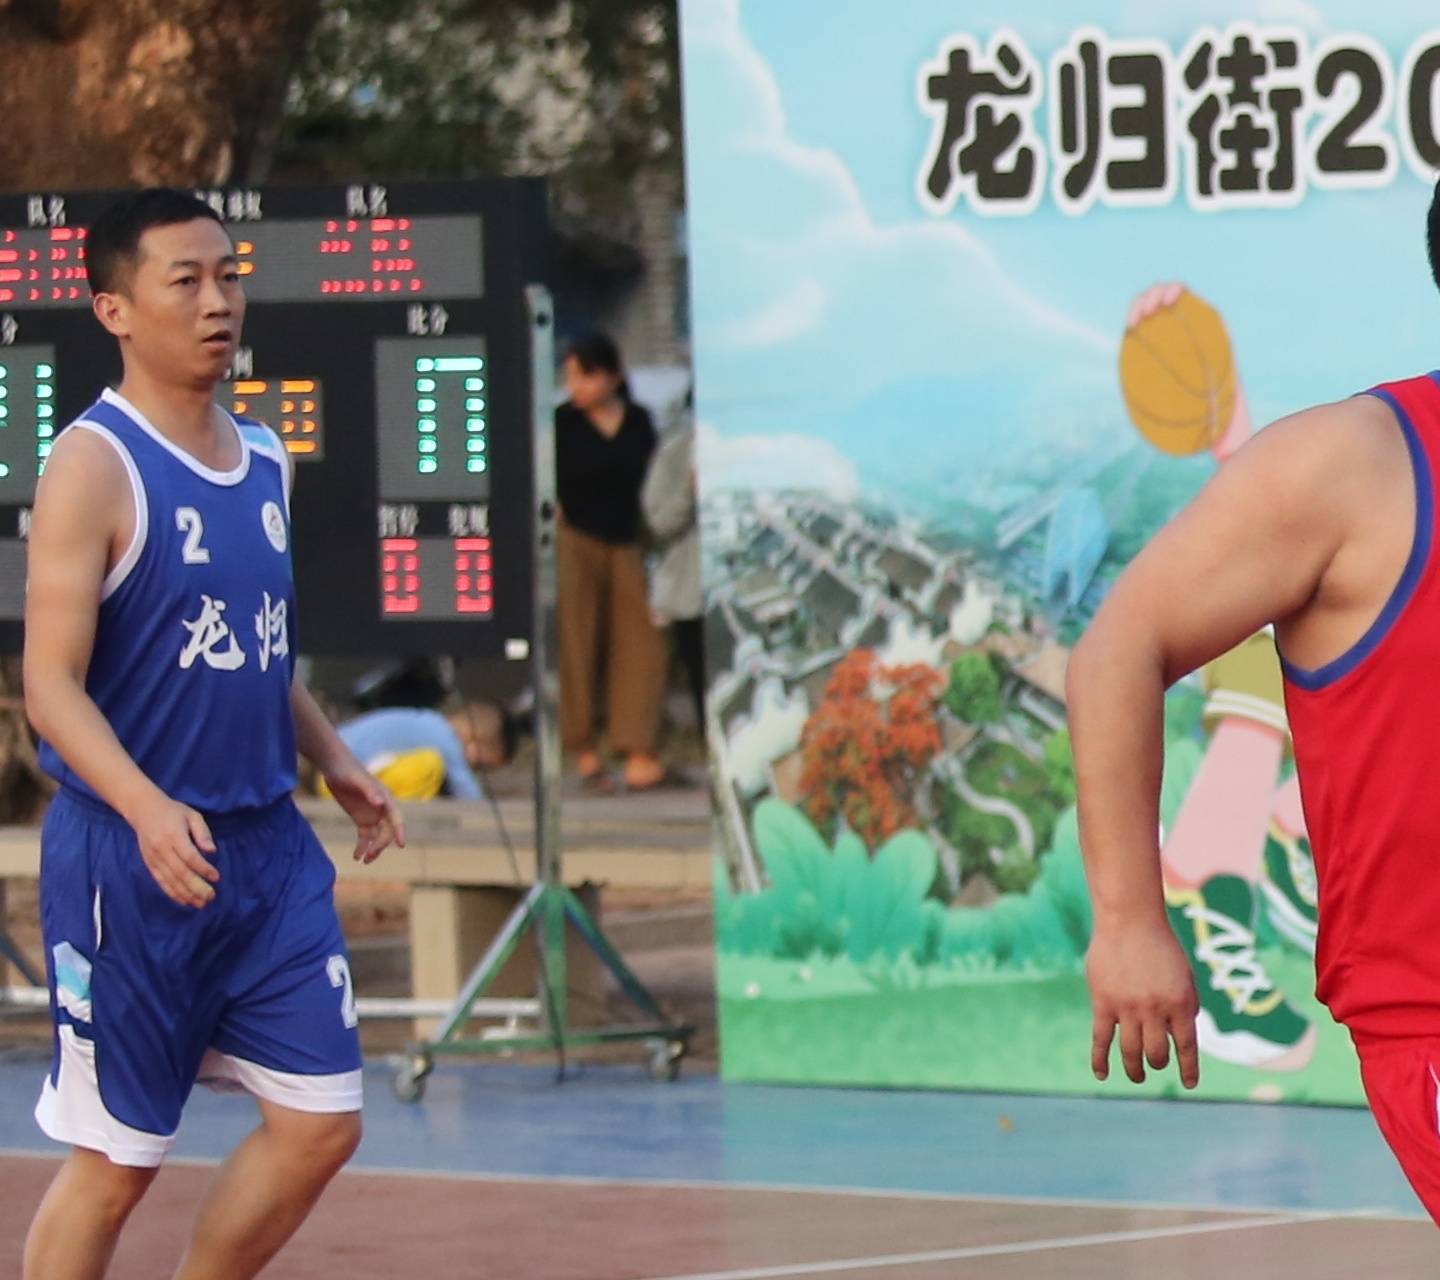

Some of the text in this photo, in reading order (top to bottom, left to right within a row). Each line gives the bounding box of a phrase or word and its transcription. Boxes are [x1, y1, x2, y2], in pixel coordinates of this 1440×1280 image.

[175, 506, 210, 564] 2
[179, 591, 289, 673] 龙归
[326, 954, 359, 1031] 2
